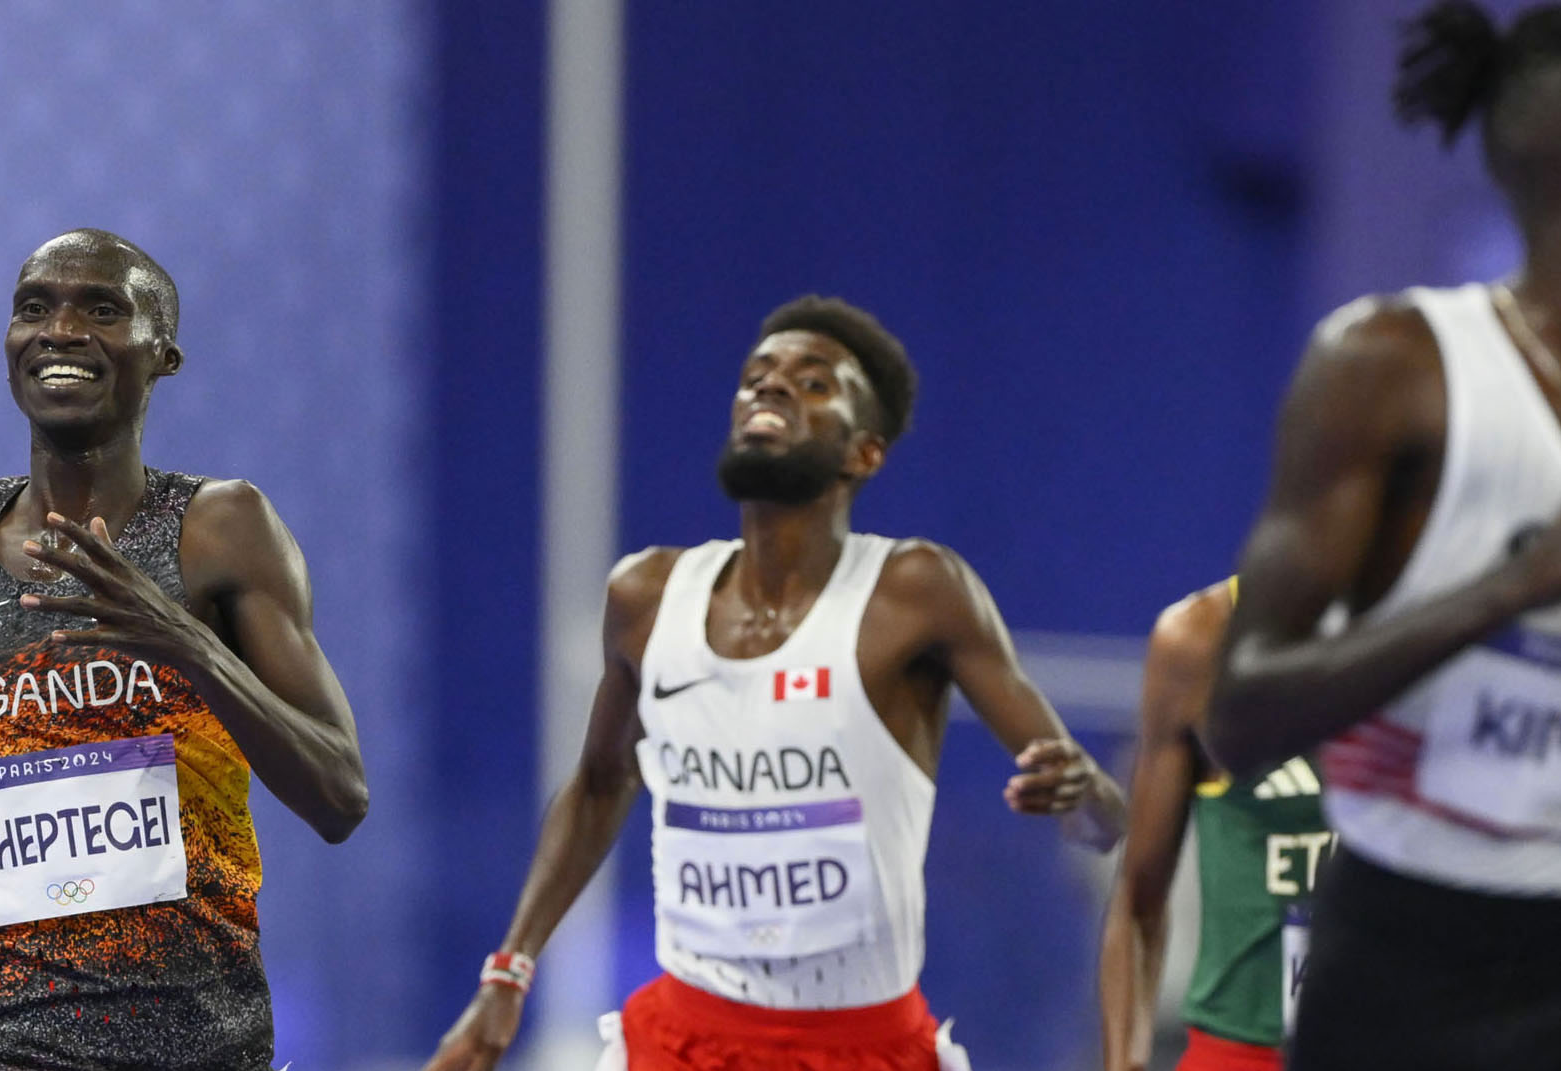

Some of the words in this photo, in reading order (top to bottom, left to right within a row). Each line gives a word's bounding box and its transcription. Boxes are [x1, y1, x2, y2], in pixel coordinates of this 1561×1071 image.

[61, 751, 113, 770] 2024
[660, 742, 851, 792] CANADA
[679, 858, 848, 908] AHMED
[1266, 831, 1339, 895] ET
